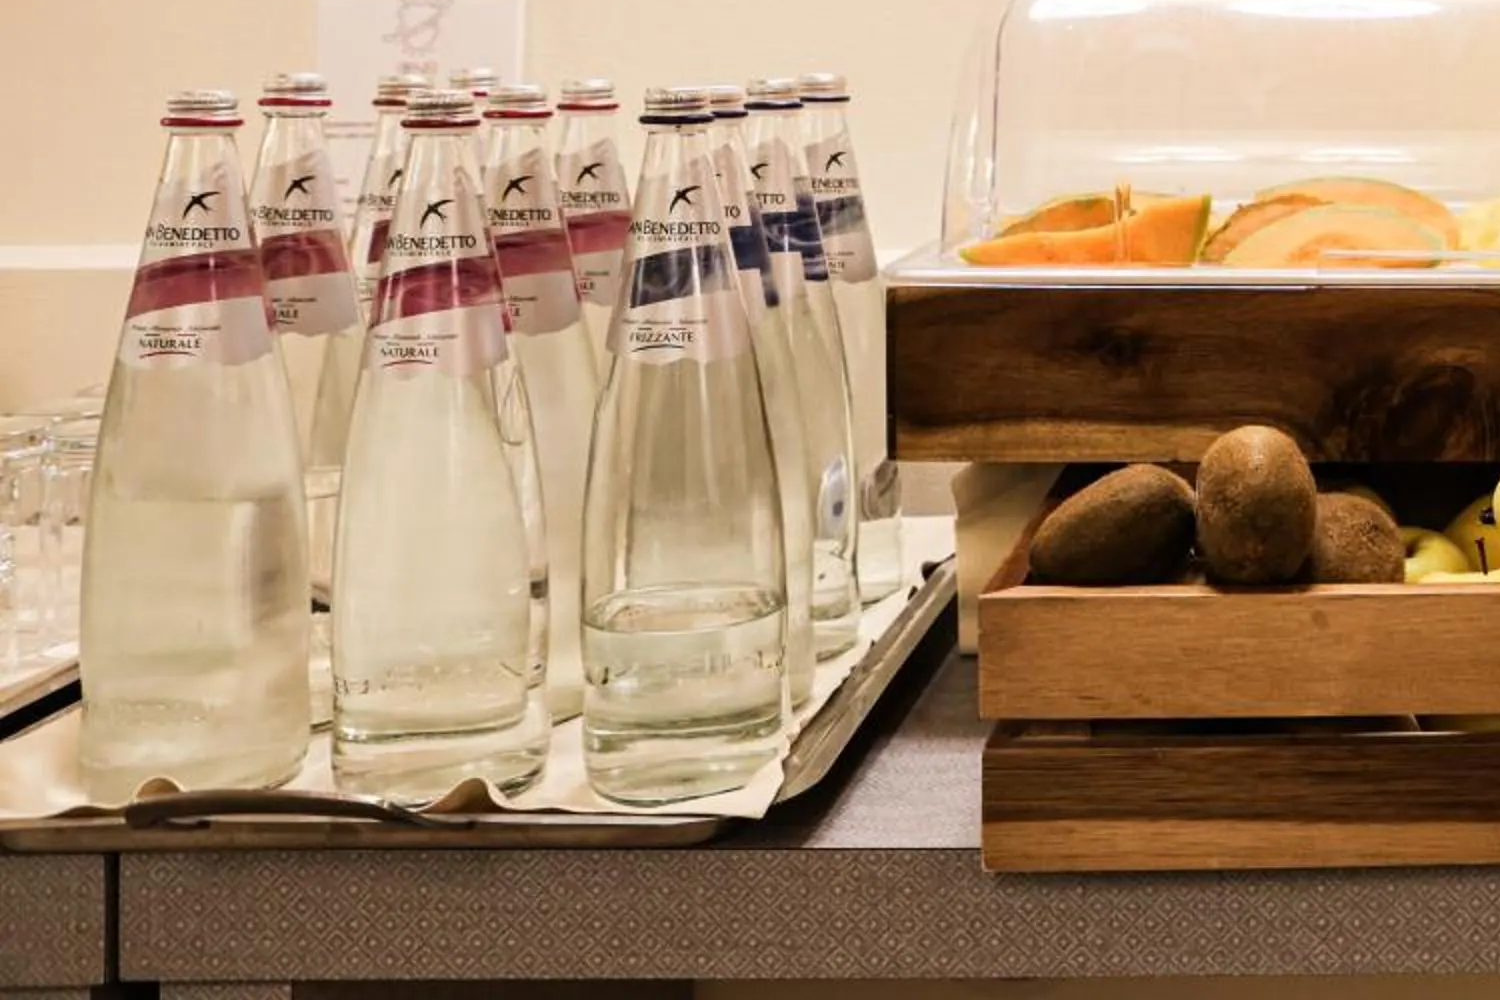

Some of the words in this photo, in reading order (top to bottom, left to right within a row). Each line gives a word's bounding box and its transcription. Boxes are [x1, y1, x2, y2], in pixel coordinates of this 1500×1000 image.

[156, 223, 240, 241] BENEDETTO
[643, 220, 720, 235] BENEDETTO
[395, 234, 477, 250] BENEDETTO
[138, 337, 202, 350] NATURALE
[629, 331, 694, 343] FRIZZANTE
[380, 346, 440, 358] NATURALE
